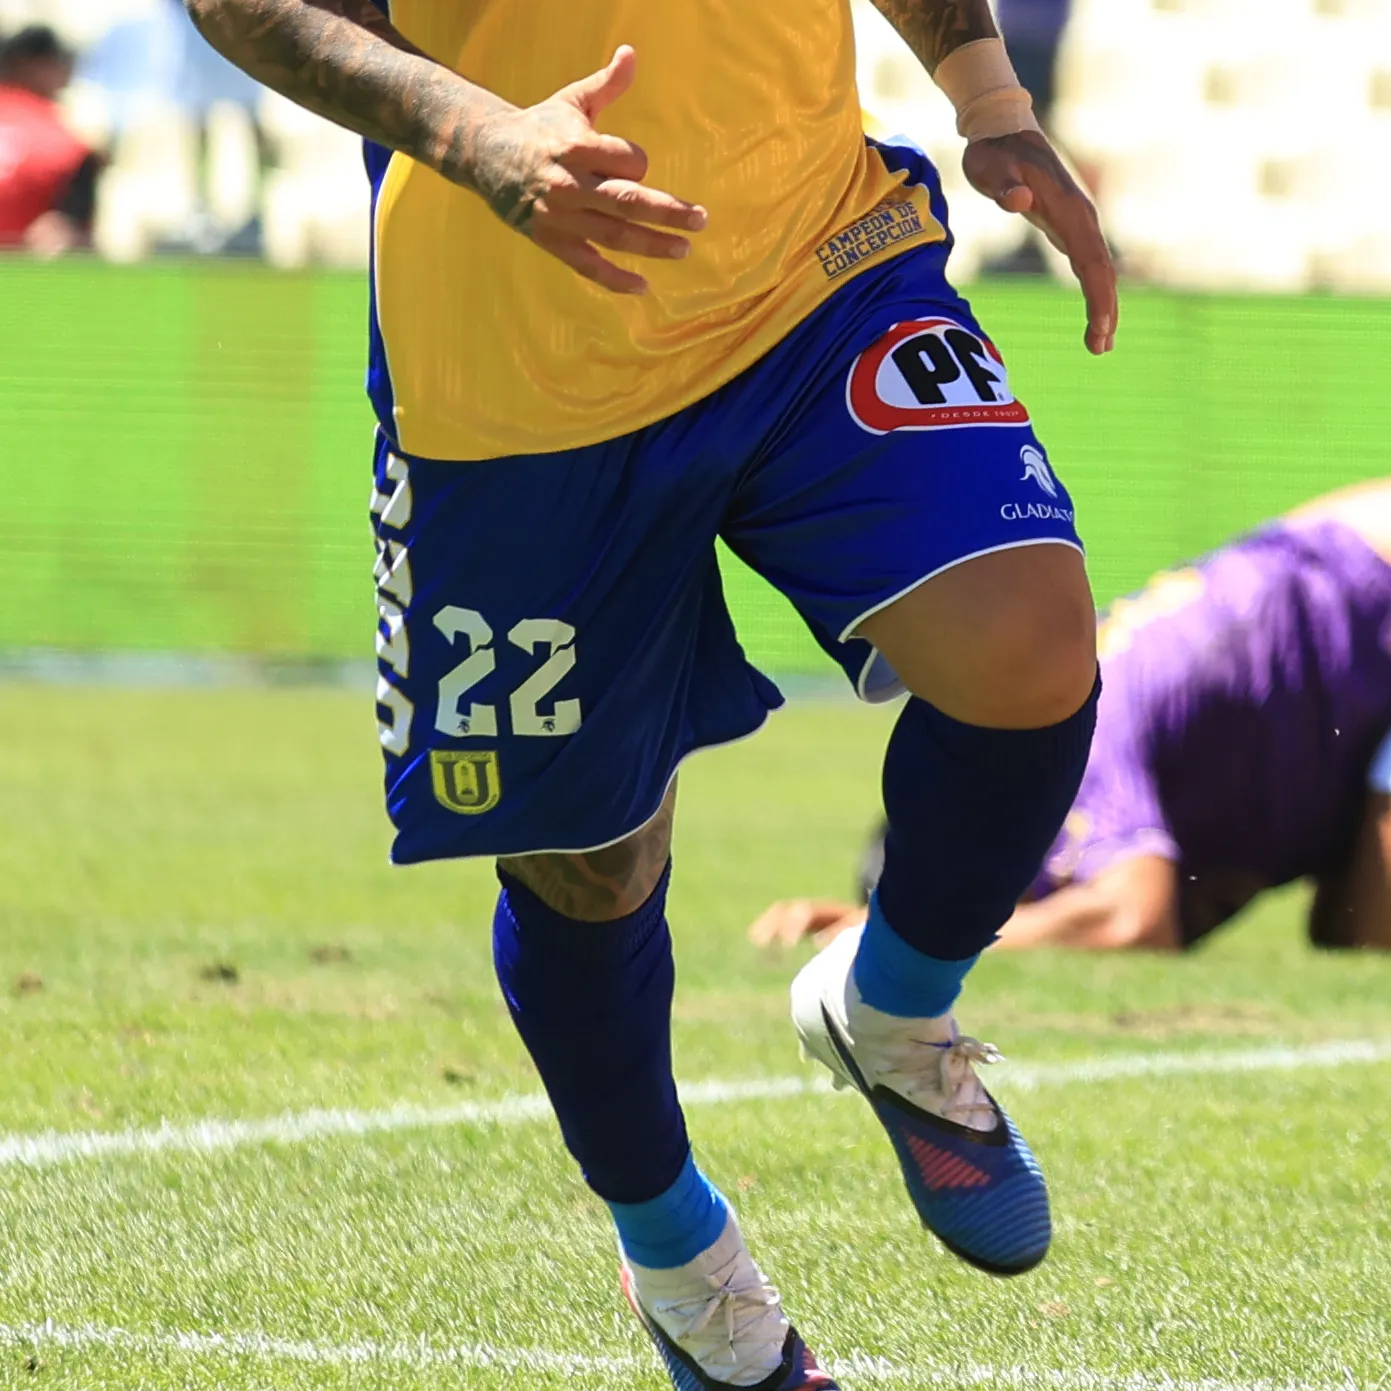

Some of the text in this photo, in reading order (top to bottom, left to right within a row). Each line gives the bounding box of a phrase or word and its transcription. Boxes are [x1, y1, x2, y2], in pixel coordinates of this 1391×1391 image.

[815, 209, 895, 263] CAMPEON
[897, 200, 919, 219] DE
[821, 215, 923, 277] CONCEPCION
[890, 327, 1001, 405] PF
[1000, 501, 1073, 522] GLADIAT
[432, 604, 583, 738] 22
